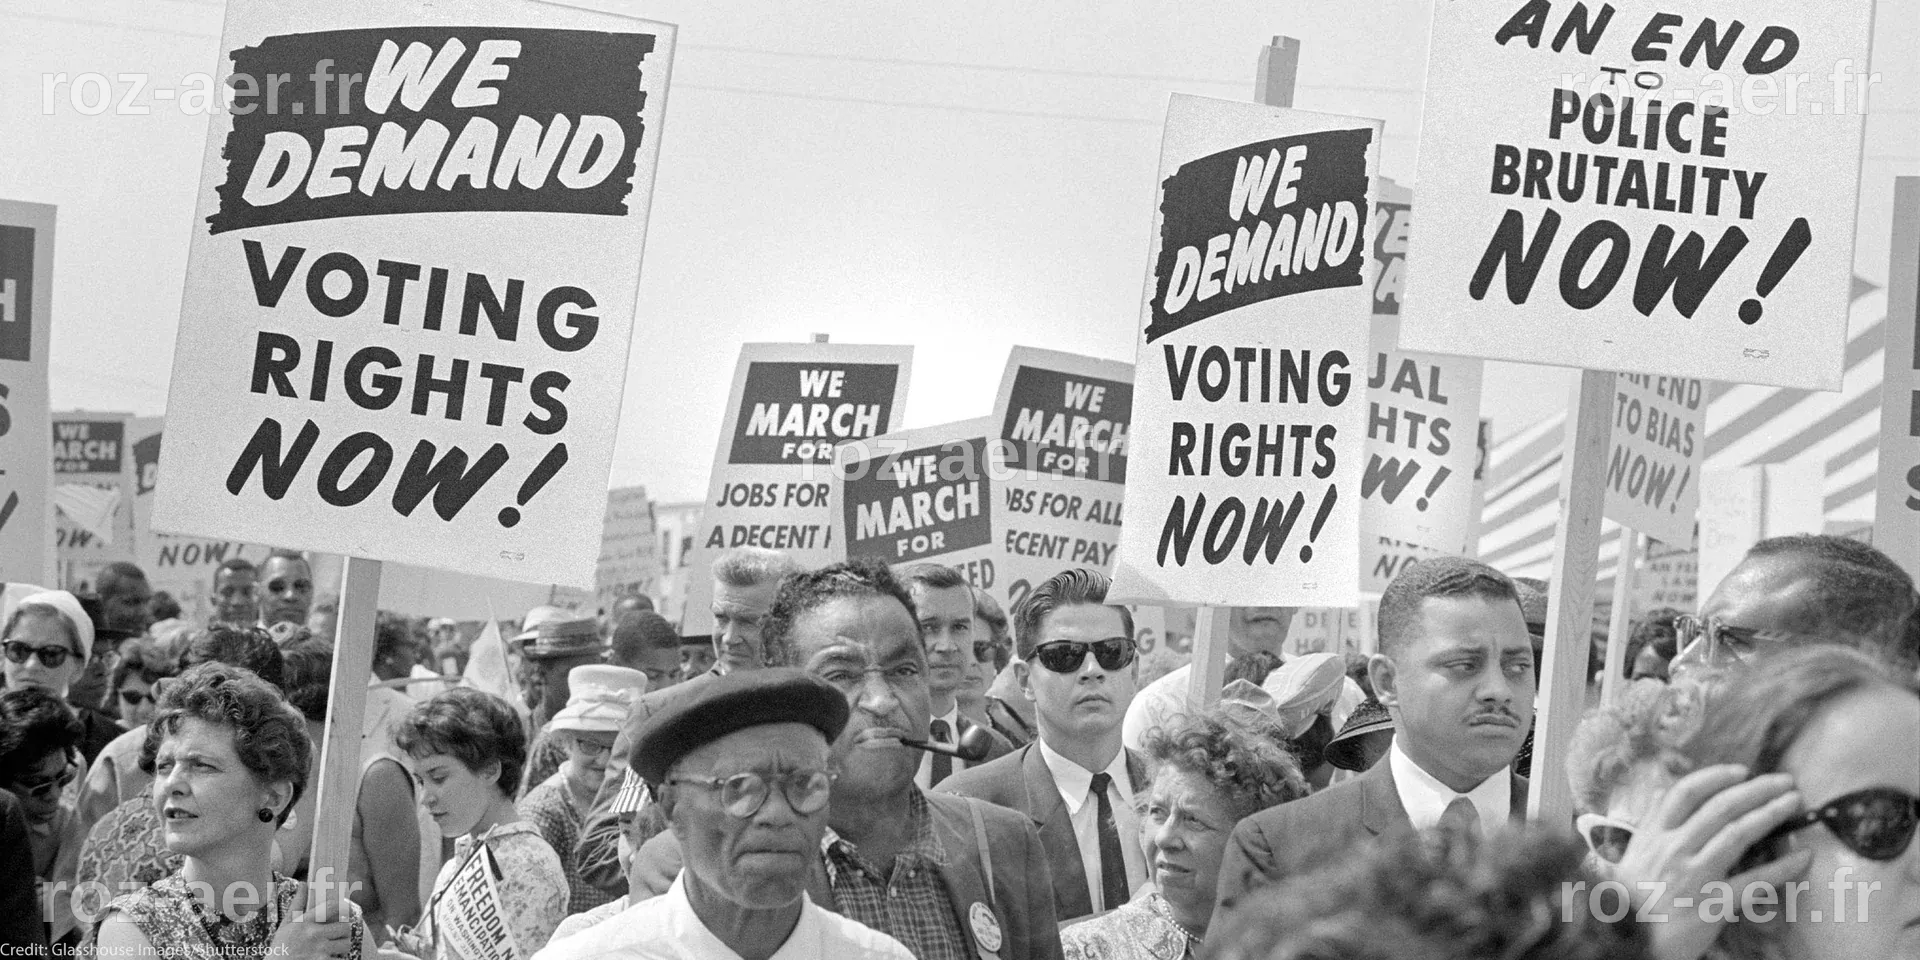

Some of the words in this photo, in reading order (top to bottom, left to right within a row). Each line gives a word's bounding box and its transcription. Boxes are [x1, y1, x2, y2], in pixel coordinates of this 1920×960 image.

[1495, 0, 1616, 56] AN
[1632, 12, 1800, 76] END
[365, 37, 522, 115] WE
[1600, 65, 1664, 90] TO
[1549, 87, 1730, 158] POLICE
[242, 112, 626, 207] DEMAND
[1229, 144, 1308, 221] WE
[1490, 143, 1768, 220] BRUTALITY
[1163, 200, 1359, 315] DEMAND
[1469, 206, 1812, 326] NOW!
[242, 239, 600, 353] VOTING
[250, 331, 572, 435] RIGHTS
[799, 369, 846, 399] WE
[1064, 381, 1107, 414] WE
[1163, 344, 1352, 407] VOTING
[1657, 376, 1702, 411] END
[58, 423, 90, 440] WE
[745, 402, 881, 438] MARCH
[781, 442, 834, 460] FOR
[1010, 407, 1132, 457] MARCH
[1168, 422, 1338, 480] RIGHTS
[1616, 391, 1642, 435] TO
[1645, 406, 1696, 458] BIAS
[226, 417, 569, 529] NOW!
[892, 454, 938, 490] WE
[1042, 451, 1090, 474] FOR
[1607, 444, 1691, 515] NOW!
[716, 482, 779, 508] JOBS
[784, 482, 831, 508] FOR
[856, 480, 980, 542] MARCH
[1006, 487, 1037, 514] BS
[1039, 490, 1083, 521] FOR
[1084, 499, 1122, 528] ALL
[1157, 483, 1338, 568] NOW!
[705, 524, 726, 550] A
[730, 524, 821, 550] DECENT
[895, 530, 945, 558] FOR
[1071, 538, 1119, 568] PAY
[465, 853, 507, 947] FREEDOM
